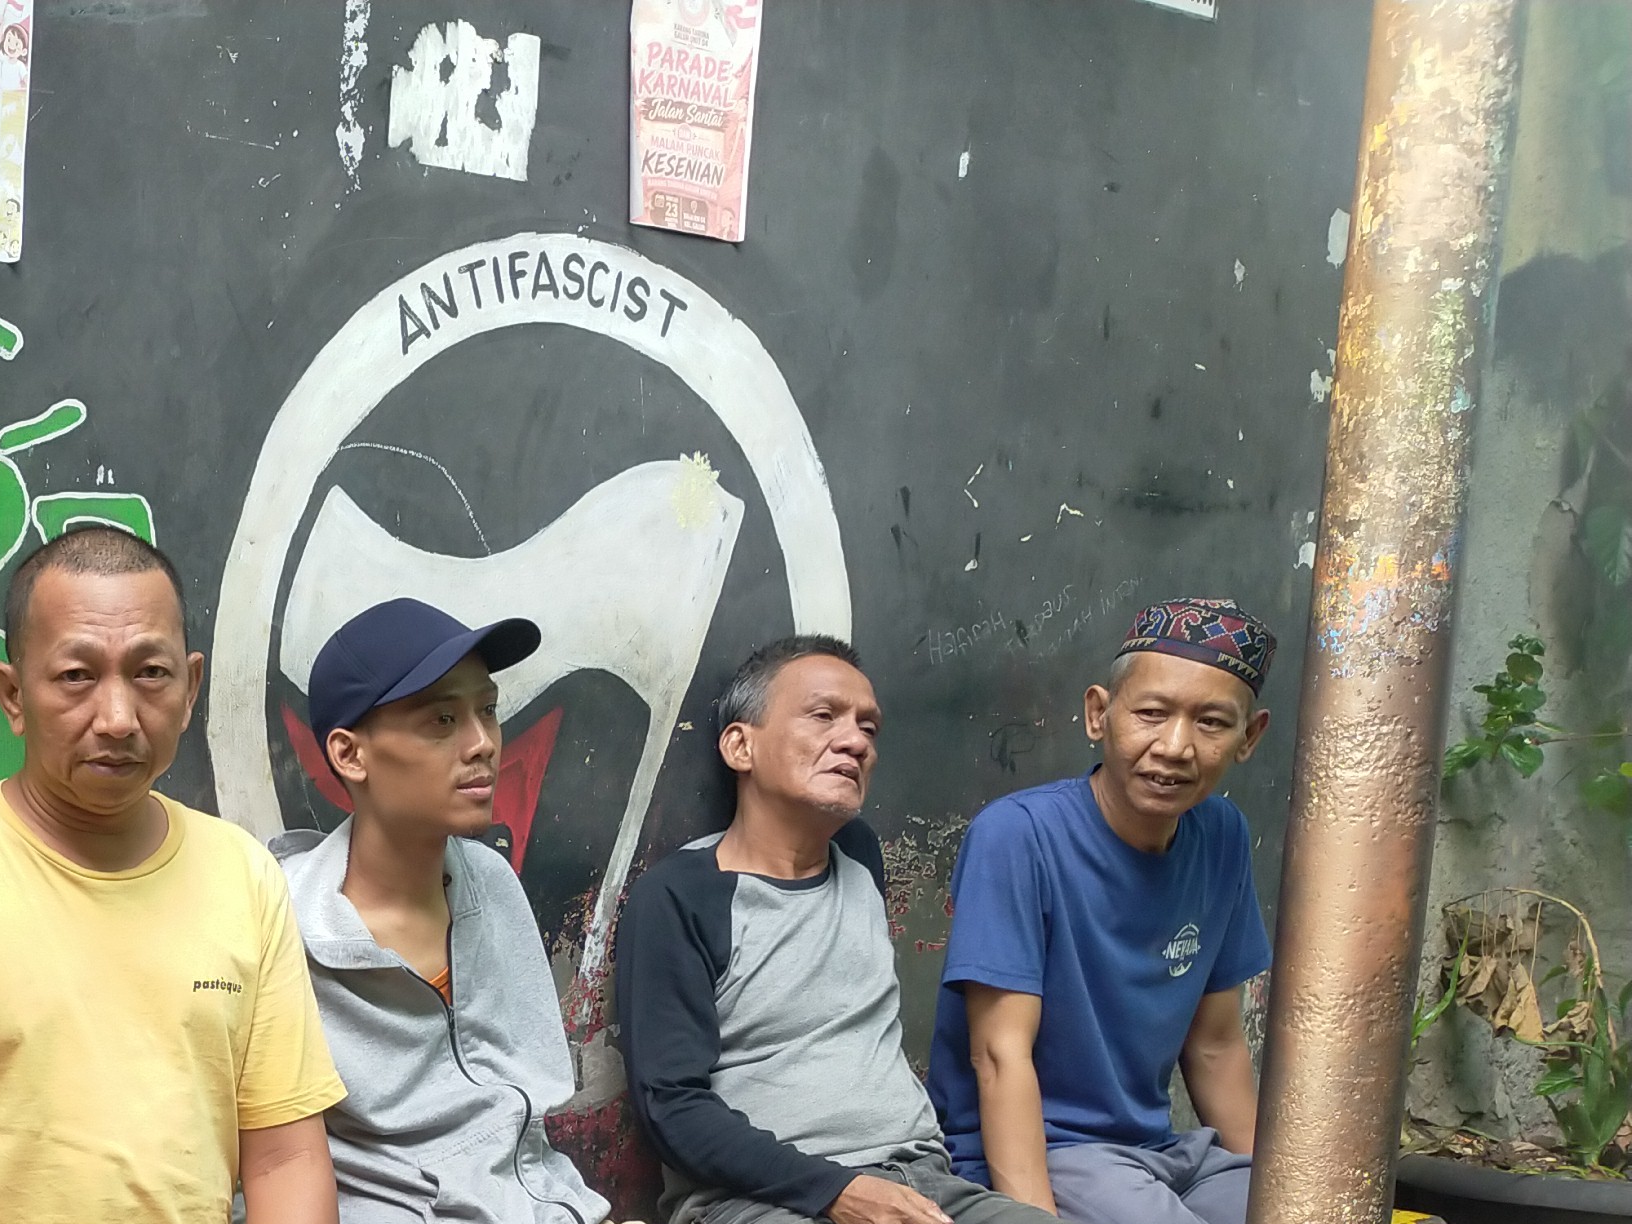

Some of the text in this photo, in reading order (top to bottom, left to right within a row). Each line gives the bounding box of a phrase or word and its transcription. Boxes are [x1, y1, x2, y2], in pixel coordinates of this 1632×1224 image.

[647, 41, 731, 82] PARADE
[638, 67, 736, 108] KARNAVAL
[648, 99, 724, 127] Jalan Santai
[650, 135, 722, 161] MALAM PUNCAK
[641, 149, 724, 186] KESENIAN
[665, 202, 678, 218] 23
[398, 250, 689, 356] ANTIFASCIST
